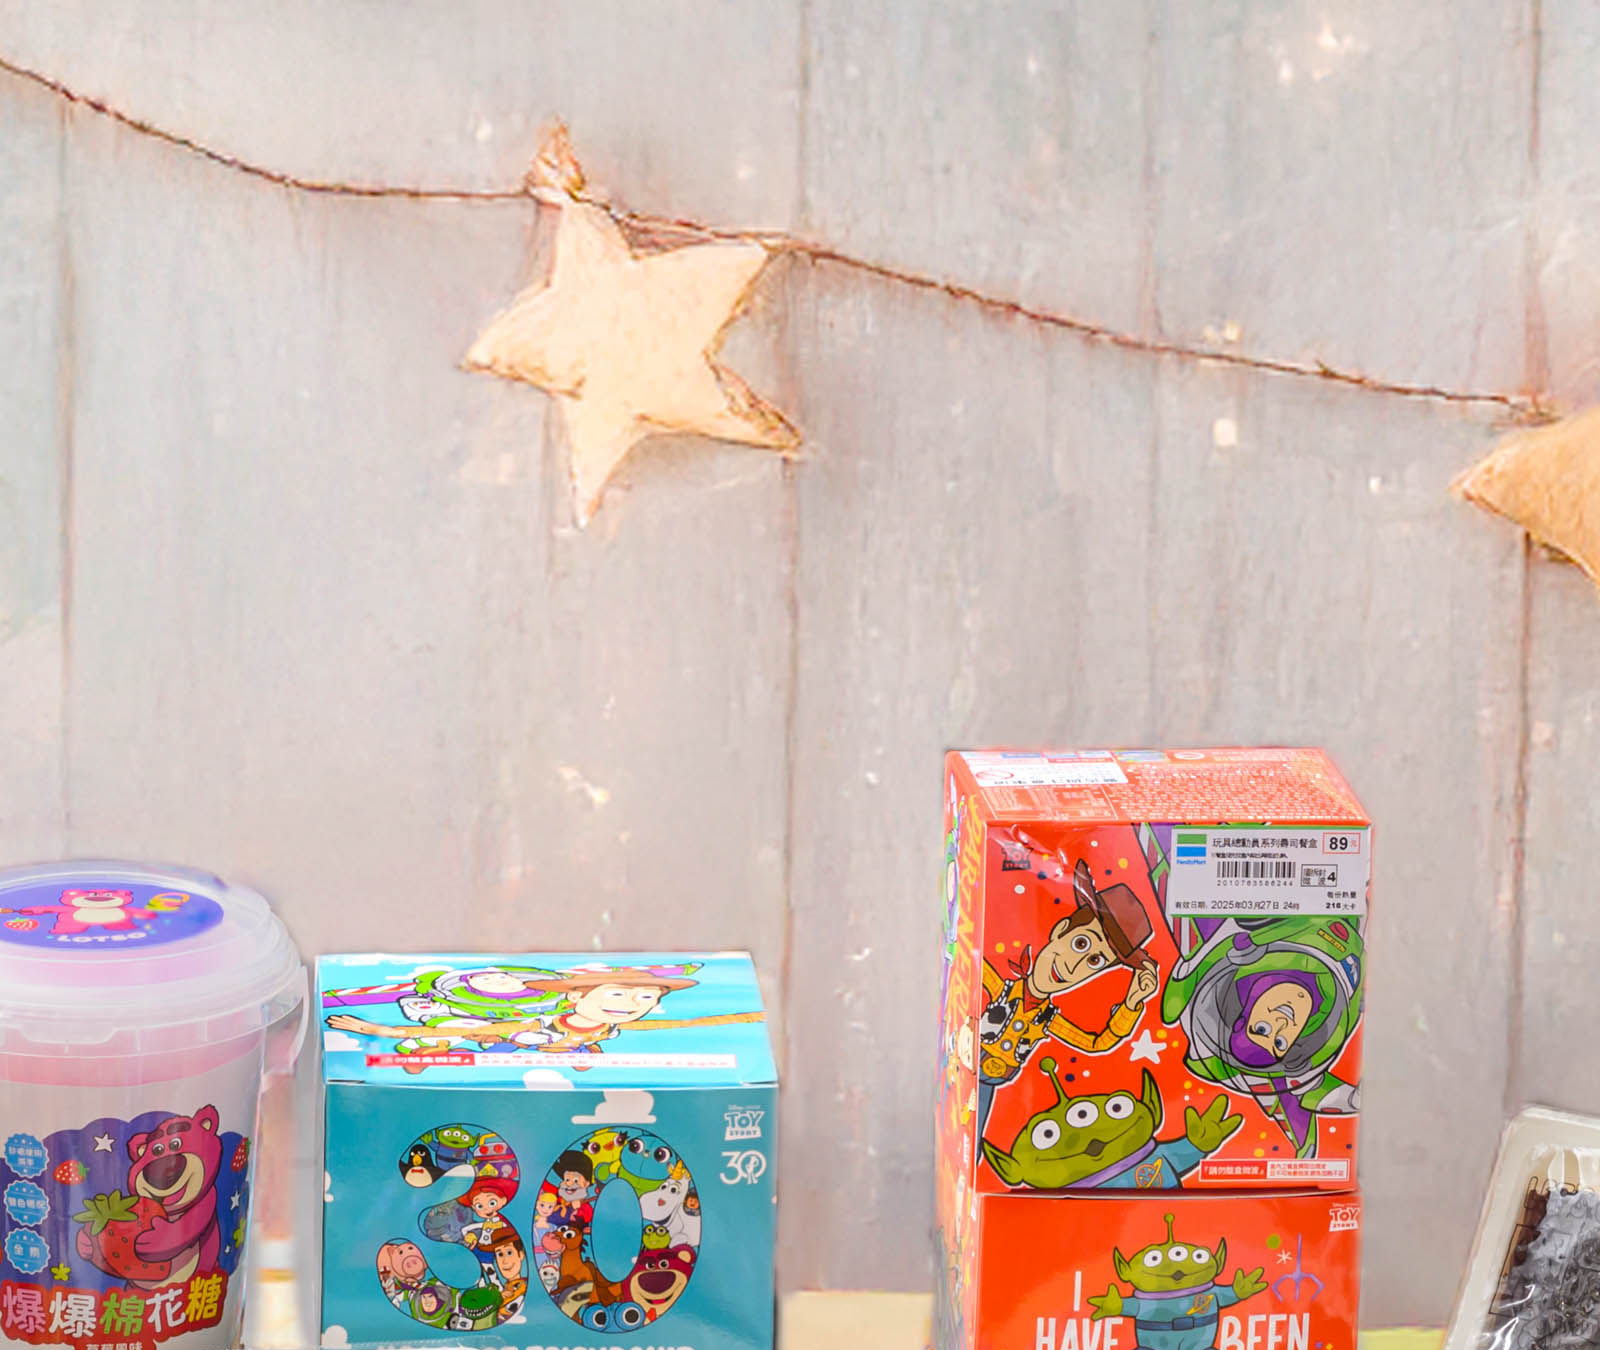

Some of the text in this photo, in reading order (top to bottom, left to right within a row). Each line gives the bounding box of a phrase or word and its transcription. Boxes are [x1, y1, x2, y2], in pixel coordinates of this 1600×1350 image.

[1329, 837, 1348, 850] 89
[1327, 872, 1336, 882] 4
[724, 1111, 766, 1129] TOY
[1329, 1207, 1361, 1224] TOY
[1074, 1270, 1082, 1311] I
[2, 1273, 223, 1338] 爆爆棉花糖
